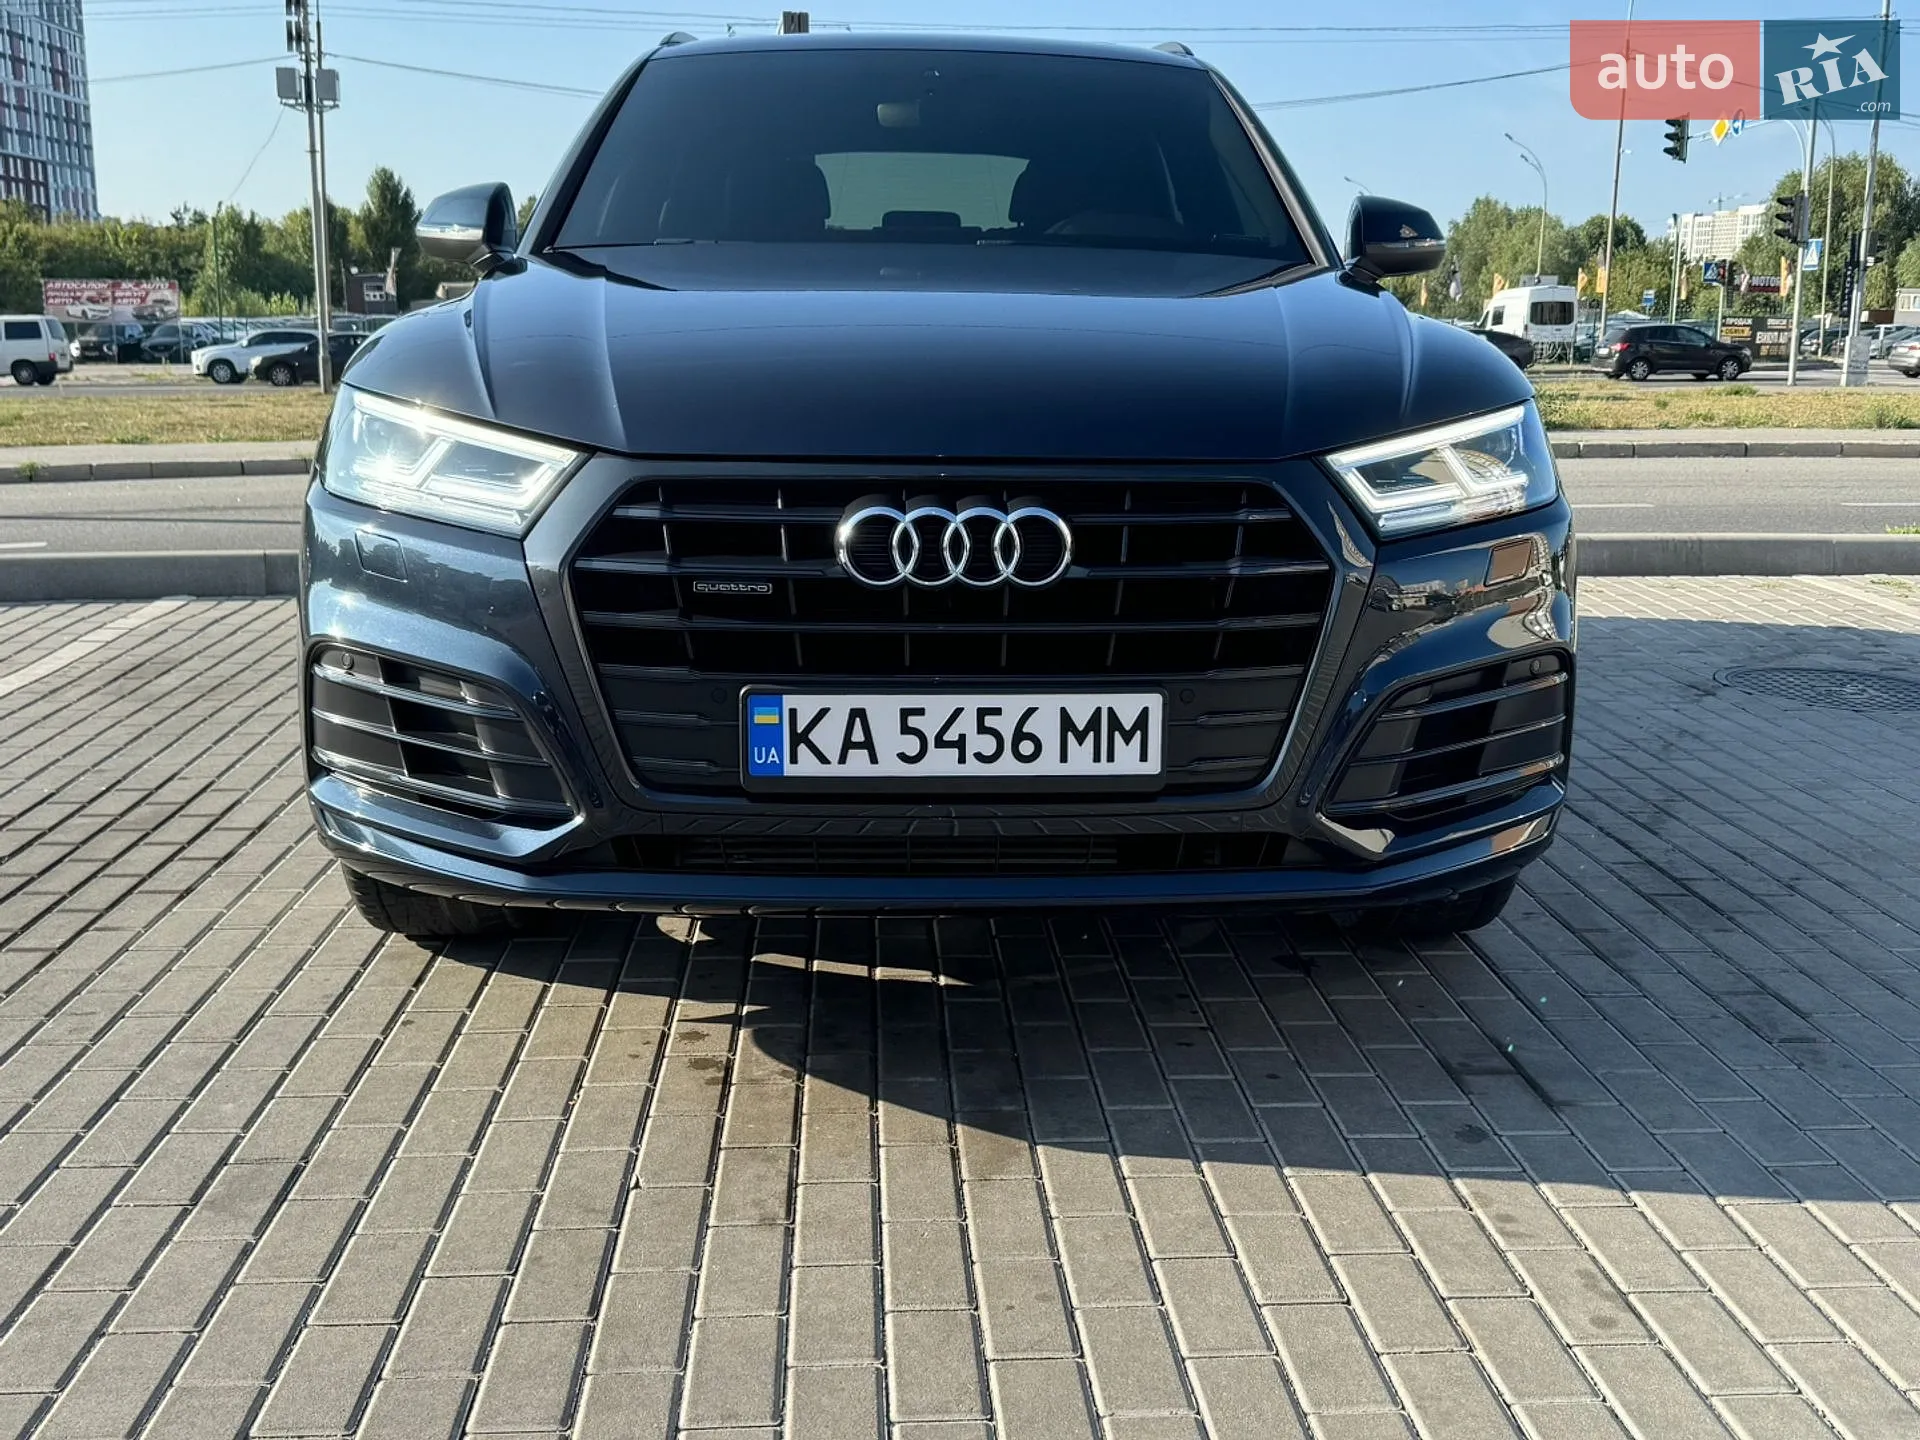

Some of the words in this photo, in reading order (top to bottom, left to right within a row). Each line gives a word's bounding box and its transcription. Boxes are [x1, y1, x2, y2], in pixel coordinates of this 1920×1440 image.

[696, 583, 768, 592] quattro
[788, 707, 879, 765] KA
[896, 706, 1043, 765] 5456
[1059, 706, 1149, 764] MM
[754, 746, 780, 764] UA
